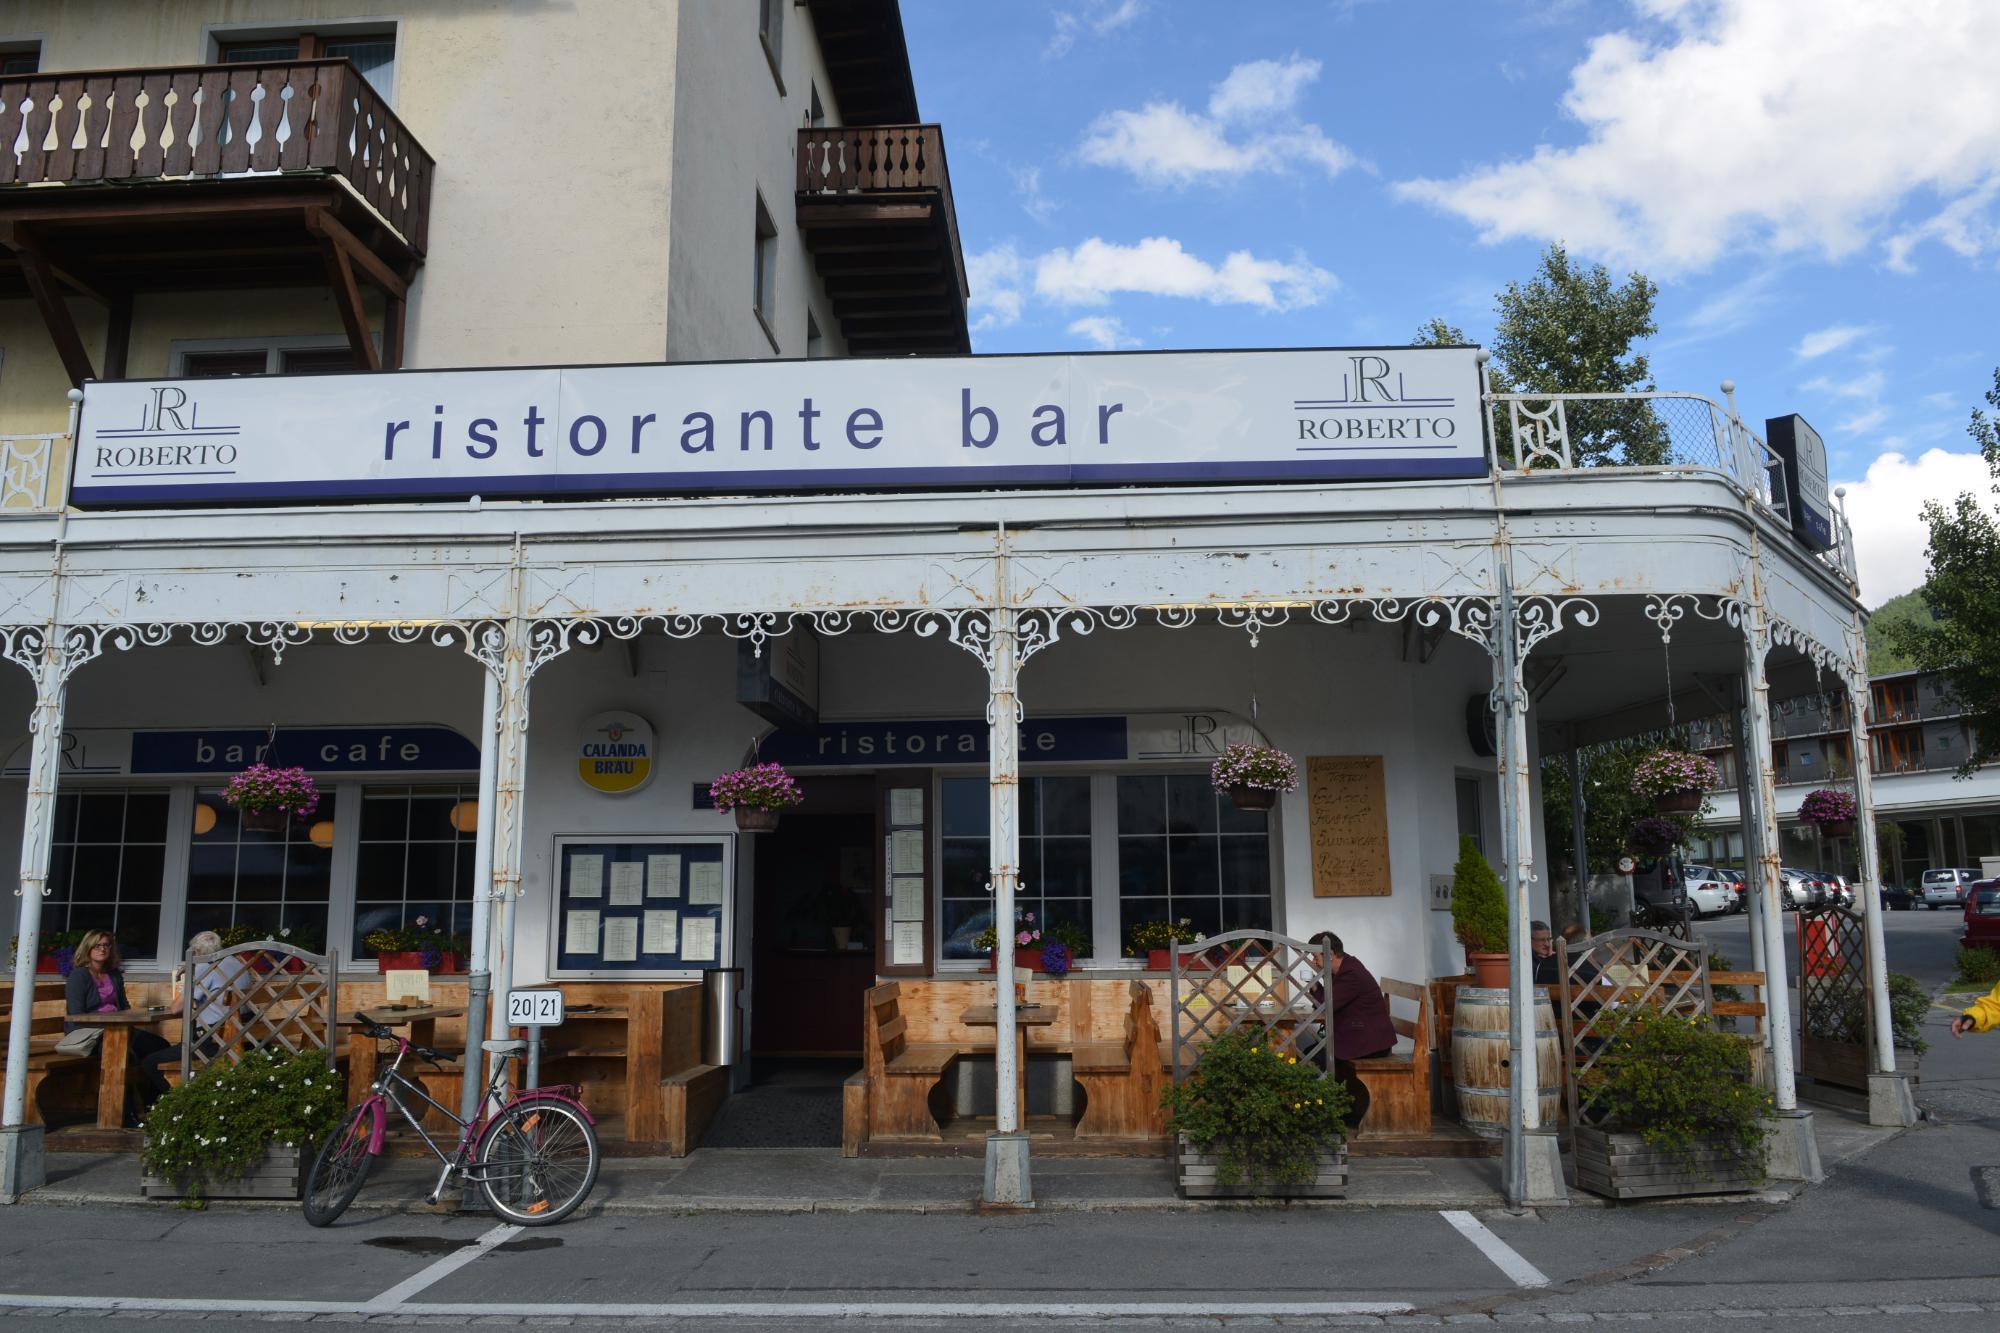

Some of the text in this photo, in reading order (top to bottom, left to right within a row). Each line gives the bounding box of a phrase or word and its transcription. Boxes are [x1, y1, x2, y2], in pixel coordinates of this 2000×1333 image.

[383, 388, 1124, 460] ristorante bar
[1297, 417, 1455, 440] ROBERTO
[95, 444, 237, 468] ROBERTO
[196, 735, 421, 763] bar cafe
[583, 743, 646, 758] CALANDA
[819, 729, 1056, 754] ristorate
[594, 759, 634, 774] BRÄU
